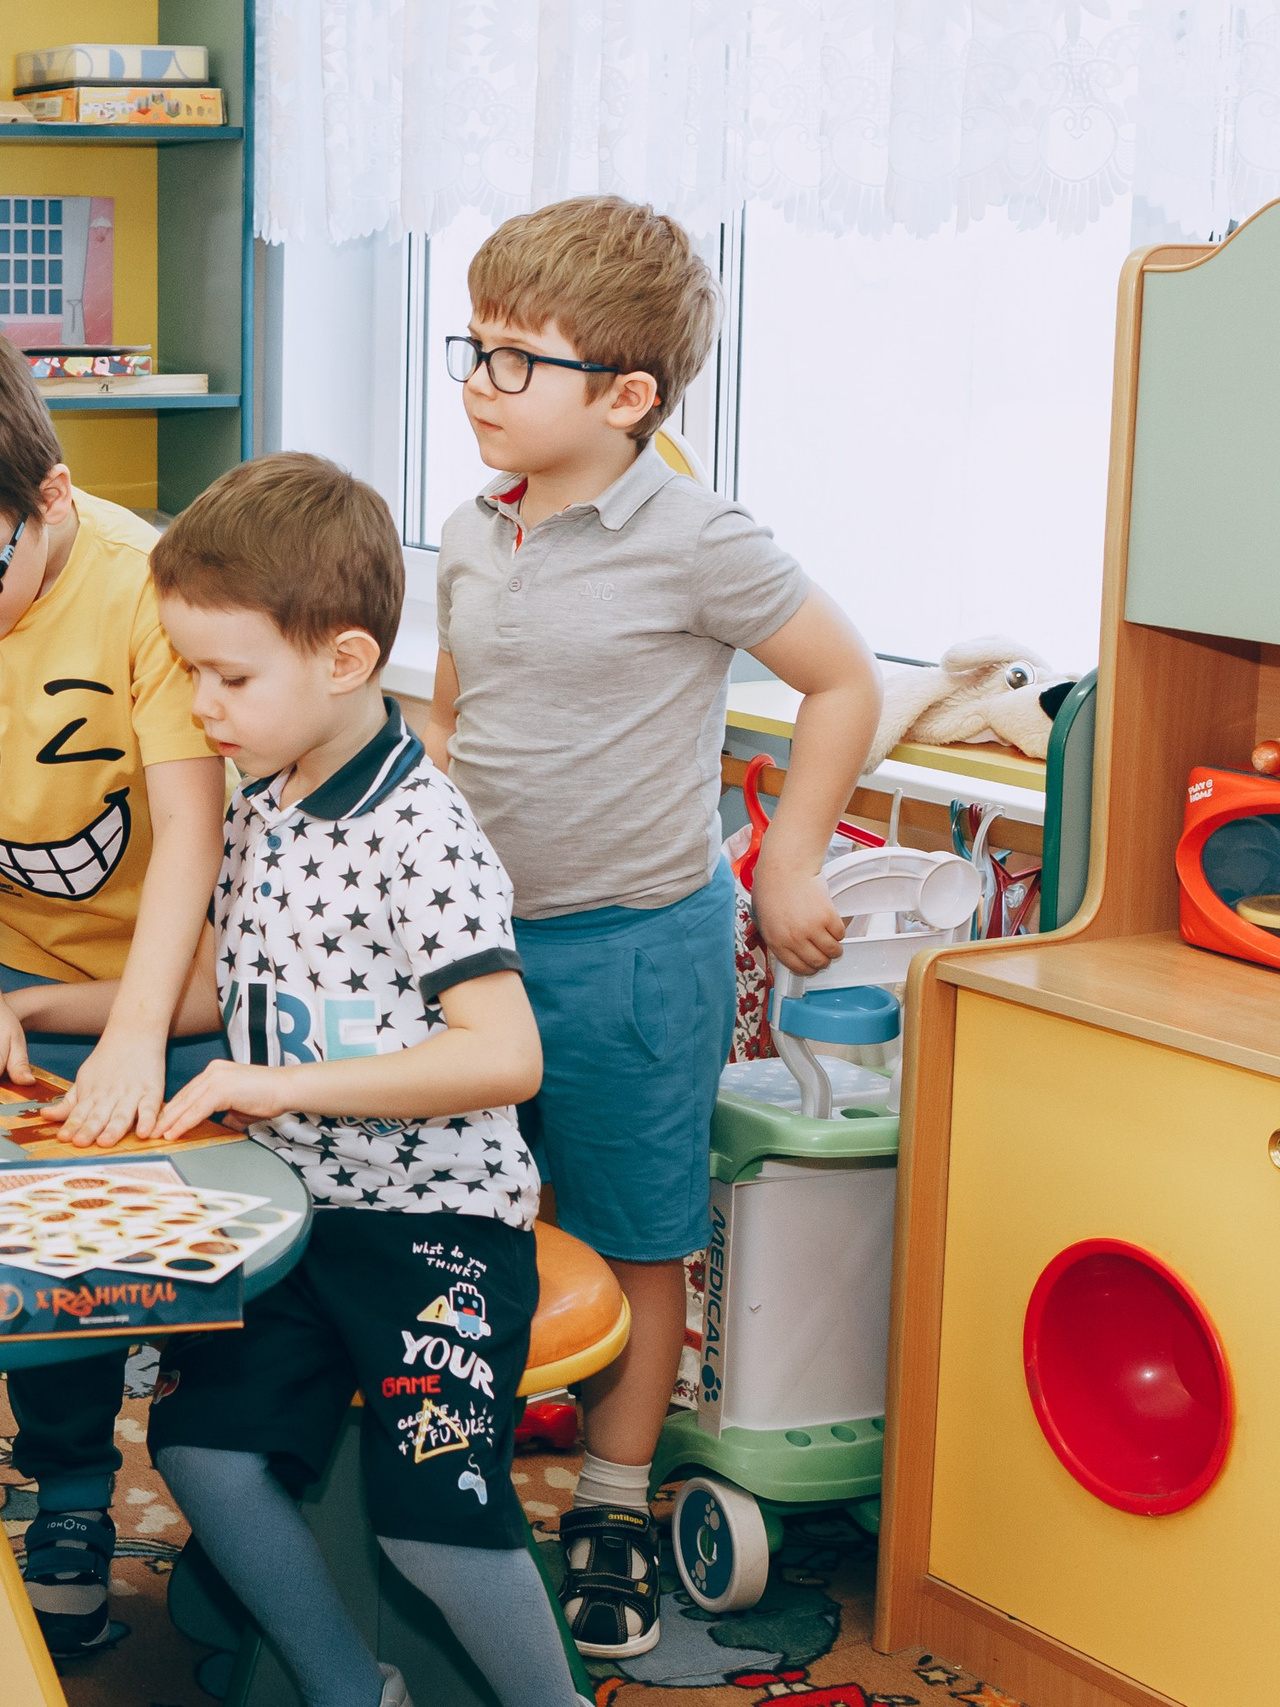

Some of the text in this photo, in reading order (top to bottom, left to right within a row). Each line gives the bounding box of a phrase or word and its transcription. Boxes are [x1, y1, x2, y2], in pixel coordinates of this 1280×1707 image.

[1190, 788, 1213, 803] HOME
[450, 1245, 464, 1258] do
[705, 1205, 727, 1362] MEDICAL
[401, 1330, 495, 1400] YOUR
[382, 1374, 441, 1398] GAME
[429, 1415, 486, 1448] FUTURE
